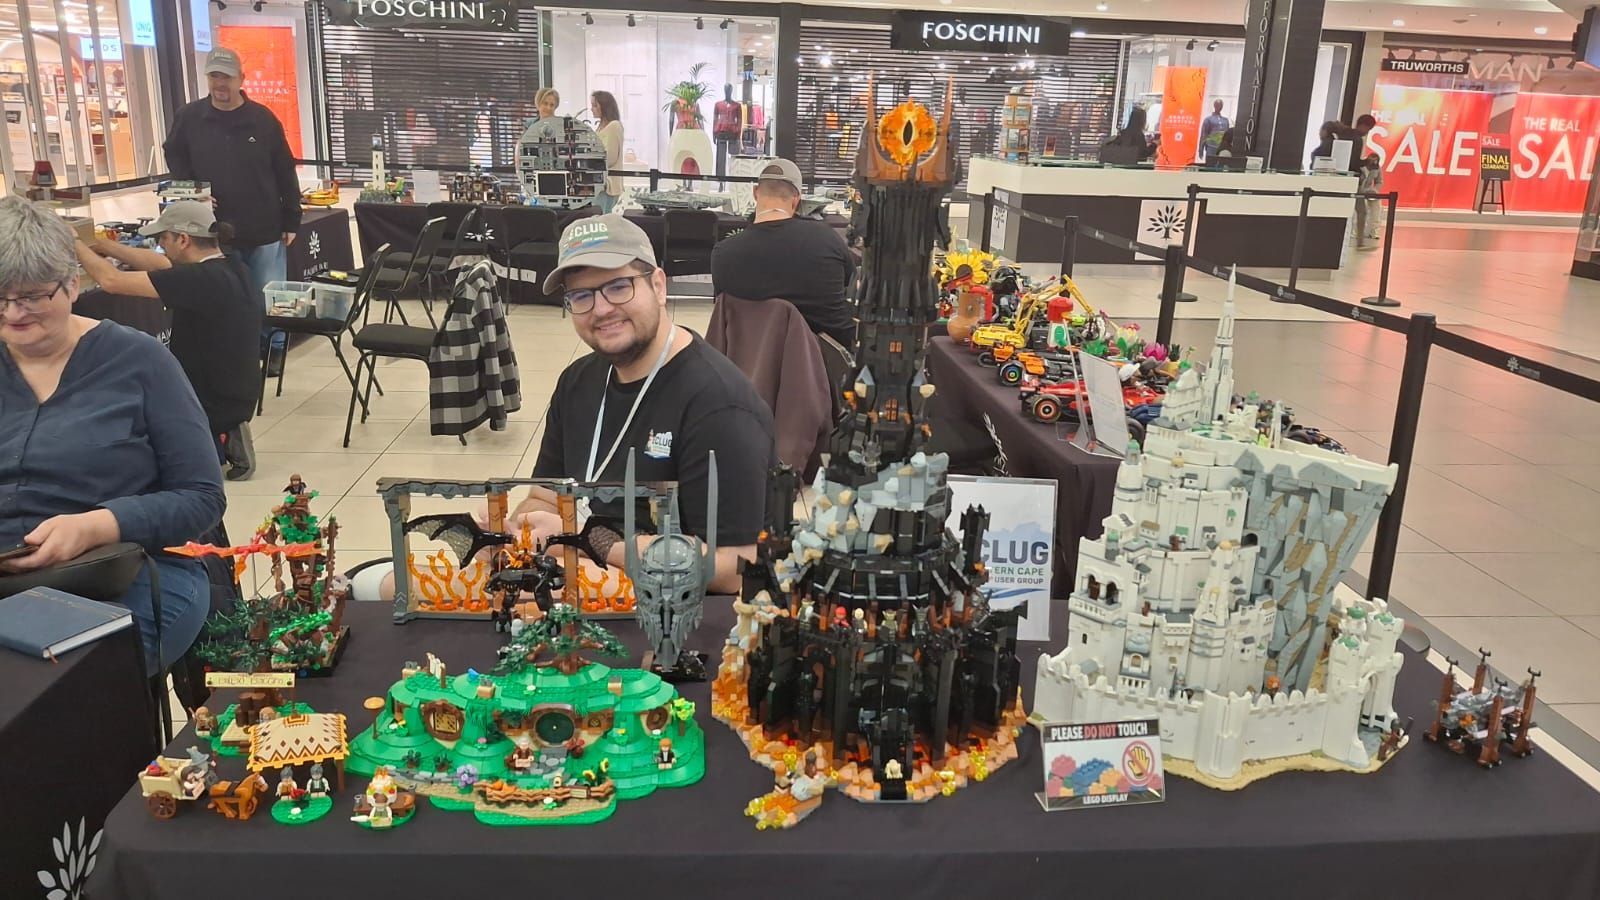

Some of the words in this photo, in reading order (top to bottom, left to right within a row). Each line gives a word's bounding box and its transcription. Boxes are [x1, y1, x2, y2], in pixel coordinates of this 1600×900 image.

[357, 0, 484, 20] FOSCHINI
[922, 21, 1041, 44] FOSCHINI
[89, 43, 118, 52] KDS
[1390, 60, 1464, 73] TRUWORTHS
[1464, 61, 1542, 82] MAN
[1371, 110, 1393, 123] THE
[1524, 116, 1547, 130] THE
[1549, 118, 1581, 132] REAL
[1366, 126, 1479, 176] SALE
[1513, 133, 1595, 181] SAL
[1481, 154, 1510, 165] FINAL
[1017, 567, 1044, 576] CAPE
[994, 576, 1015, 584] USER
[1016, 577, 1044, 585] GROUP
[1051, 726, 1083, 740] PLEASE
[1084, 724, 1098, 739] DO
[1099, 724, 1117, 737] NOT
[1118, 722, 1148, 736] TOUCH
[1082, 795, 1101, 805] LEGO
[1101, 793, 1129, 803] DISPLAY
